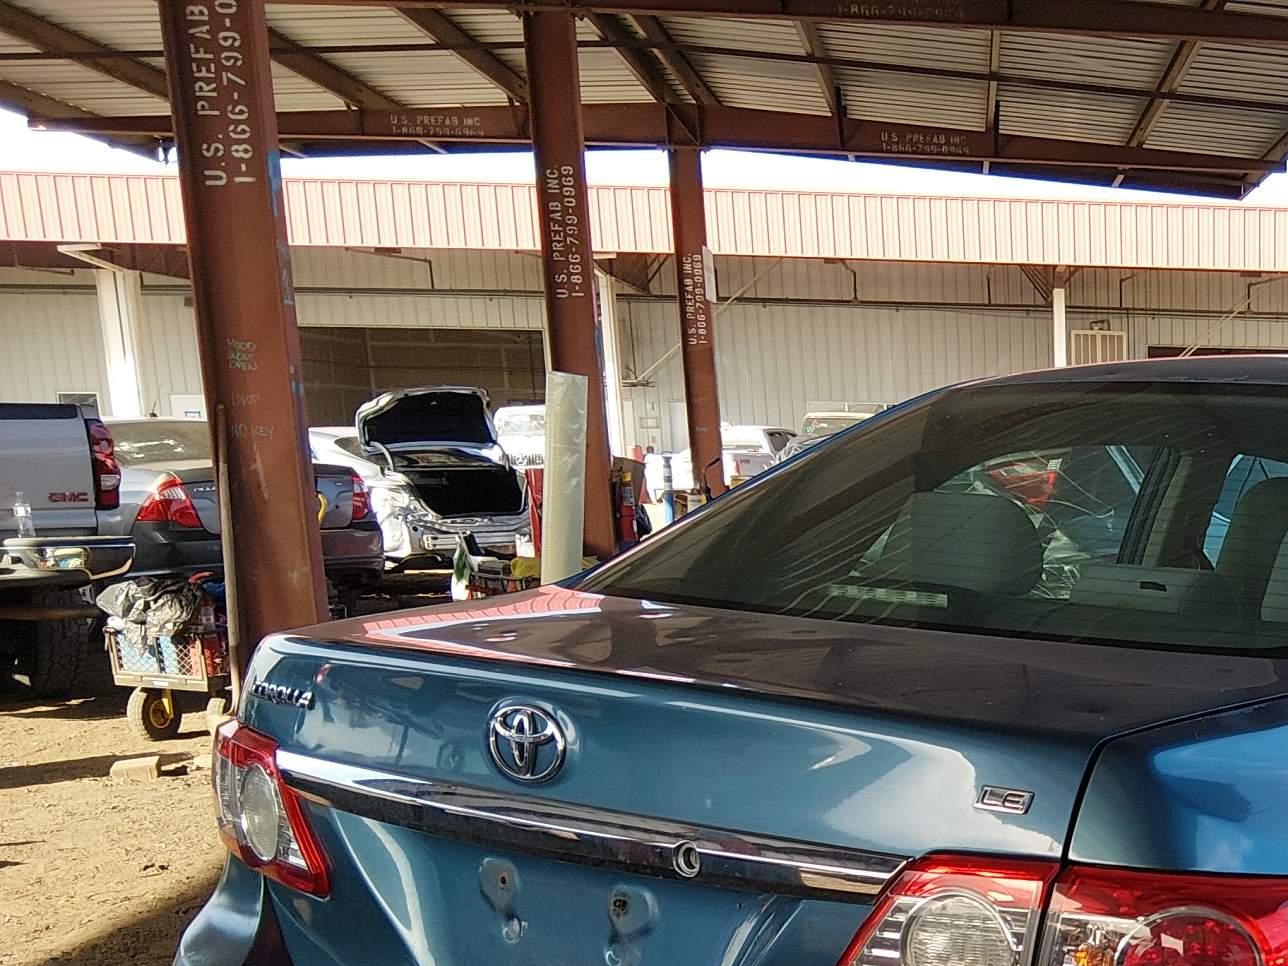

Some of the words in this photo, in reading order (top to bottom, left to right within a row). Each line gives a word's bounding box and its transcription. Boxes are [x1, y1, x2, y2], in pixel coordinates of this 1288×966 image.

[186, 4, 220, 116] PREFAB
[416, 115, 458, 126] PREFAB
[202, 133, 228, 186] U.S.
[549, 201, 566, 261] PREFAB
[561, 165, 585, 297] 1-866-799-0969
[555, 269, 569, 298] U.S.
[684, 278, 696, 319] PREFAB
[693, 254, 708, 344] 1-866-799-0969
[48, 491, 89, 503] GMC
[980, 786, 1027, 813] LE
